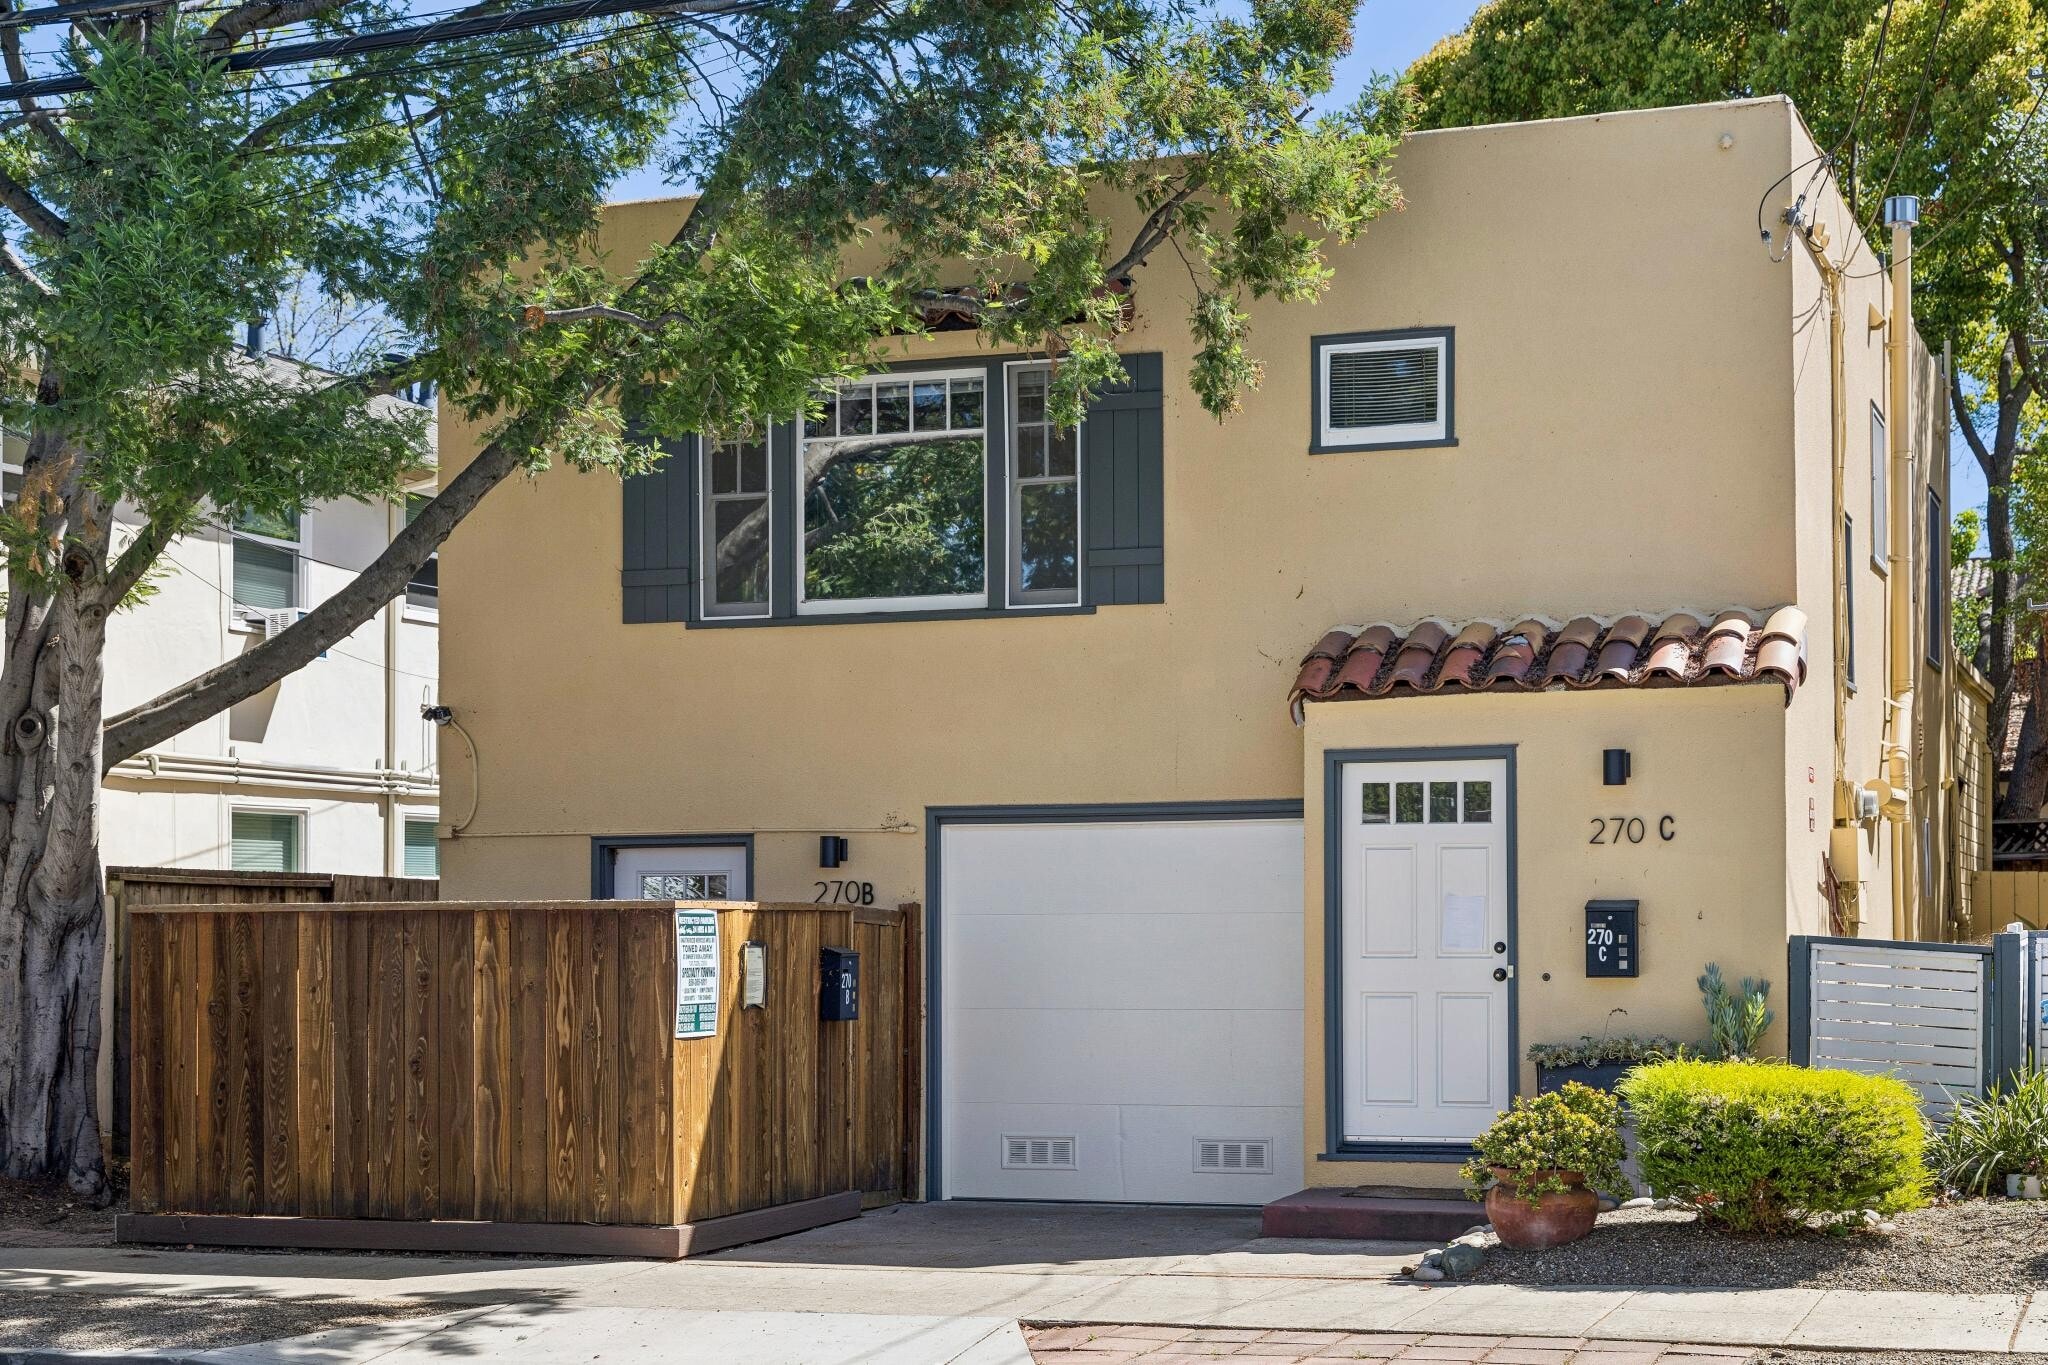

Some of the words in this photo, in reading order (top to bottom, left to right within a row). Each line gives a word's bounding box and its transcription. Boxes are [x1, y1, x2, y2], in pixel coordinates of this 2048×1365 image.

[1589, 817, 1645, 845] 270
[1659, 815, 1675, 841] C
[814, 880, 875, 905] 270B
[1587, 928, 1613, 945] 270
[682, 944, 698, 953] TOWED
[698, 944, 713, 953] AWAY
[1598, 946, 1607, 962] C
[841, 973, 852, 989] 270
